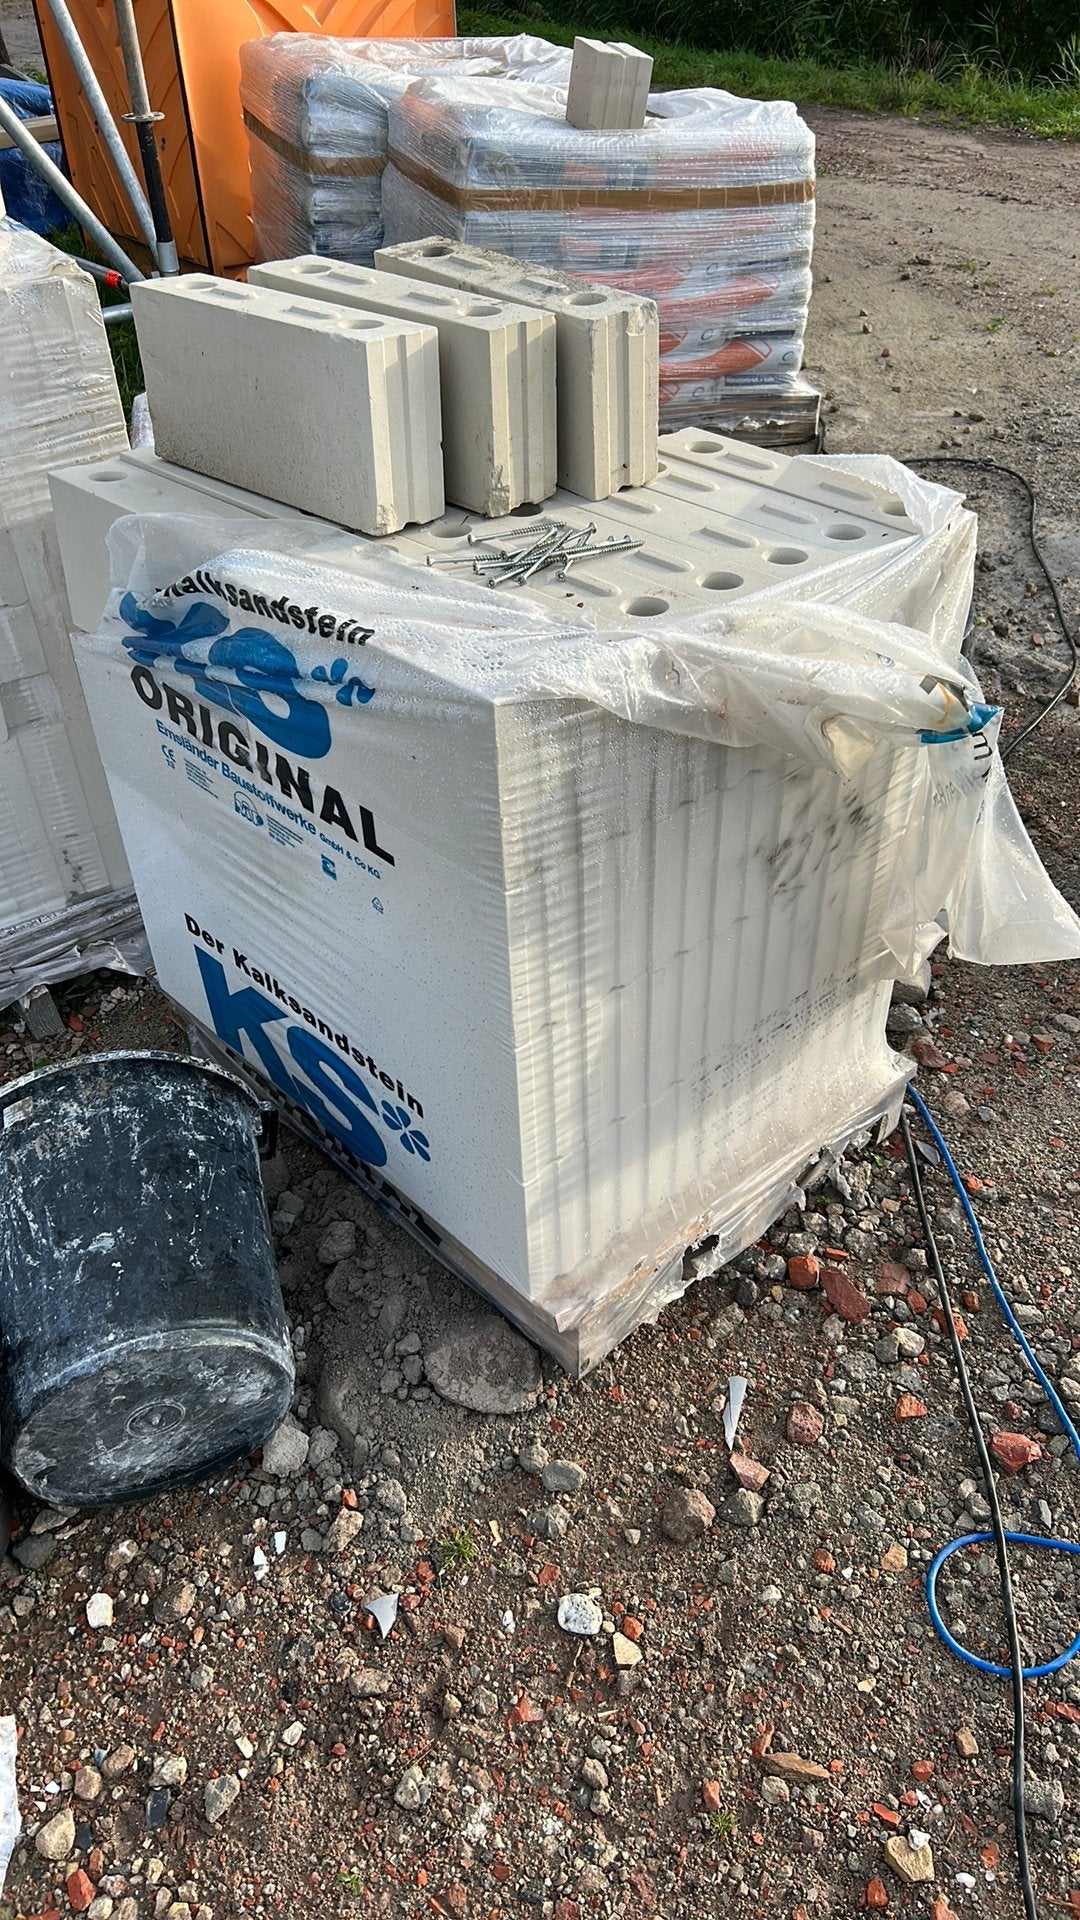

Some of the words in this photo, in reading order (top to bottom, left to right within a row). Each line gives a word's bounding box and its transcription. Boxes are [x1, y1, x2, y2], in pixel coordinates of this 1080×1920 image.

[130, 664, 396, 867] ORIGINAL
[155, 719, 220, 770] Emsländer
[221, 760, 317, 836] Baustoffwerke
[318, 832, 344, 856] GmbH
[345, 850, 353, 861] &
[354, 856, 366, 869] Co
[184, 912, 225, 955] Der
[232, 948, 425, 1119] Kalksandstein
[193, 943, 388, 1168] KS
